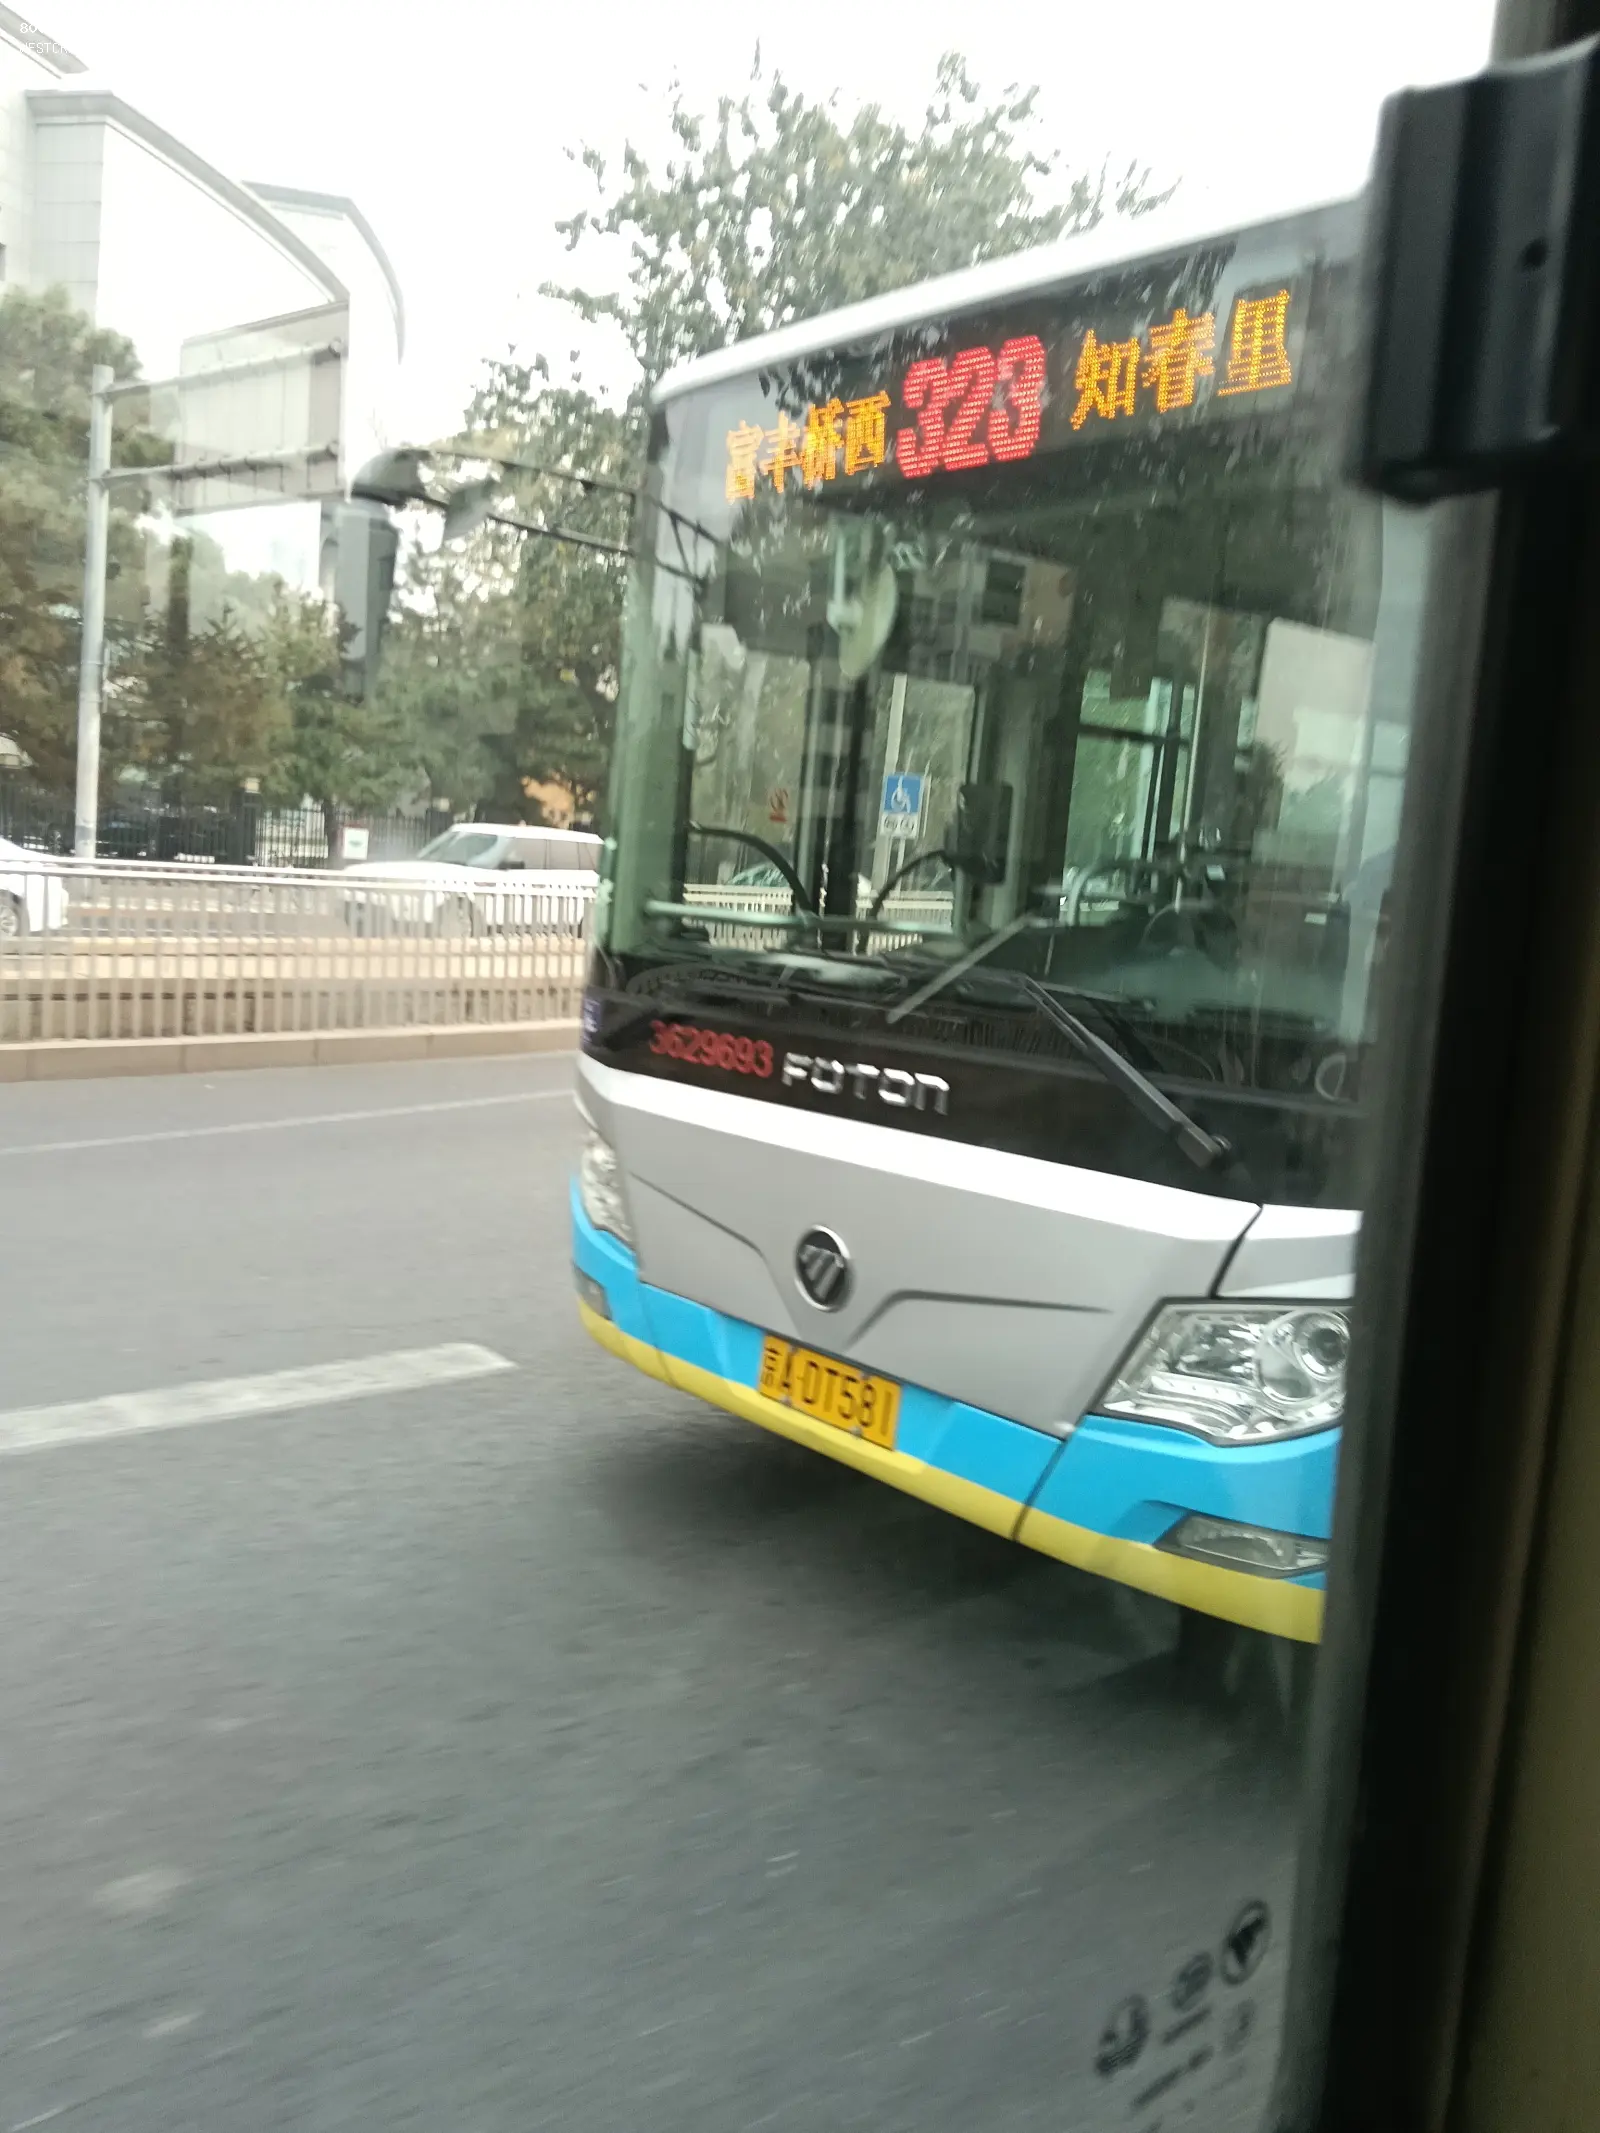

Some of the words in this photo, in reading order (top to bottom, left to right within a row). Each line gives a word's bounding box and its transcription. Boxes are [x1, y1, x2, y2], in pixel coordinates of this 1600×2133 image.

[897, 334, 1046, 479] 323
[1070, 289, 1292, 430] 知春里
[649, 1019, 773, 1078] 3629693
[782, 1051, 949, 1116] FOTON
